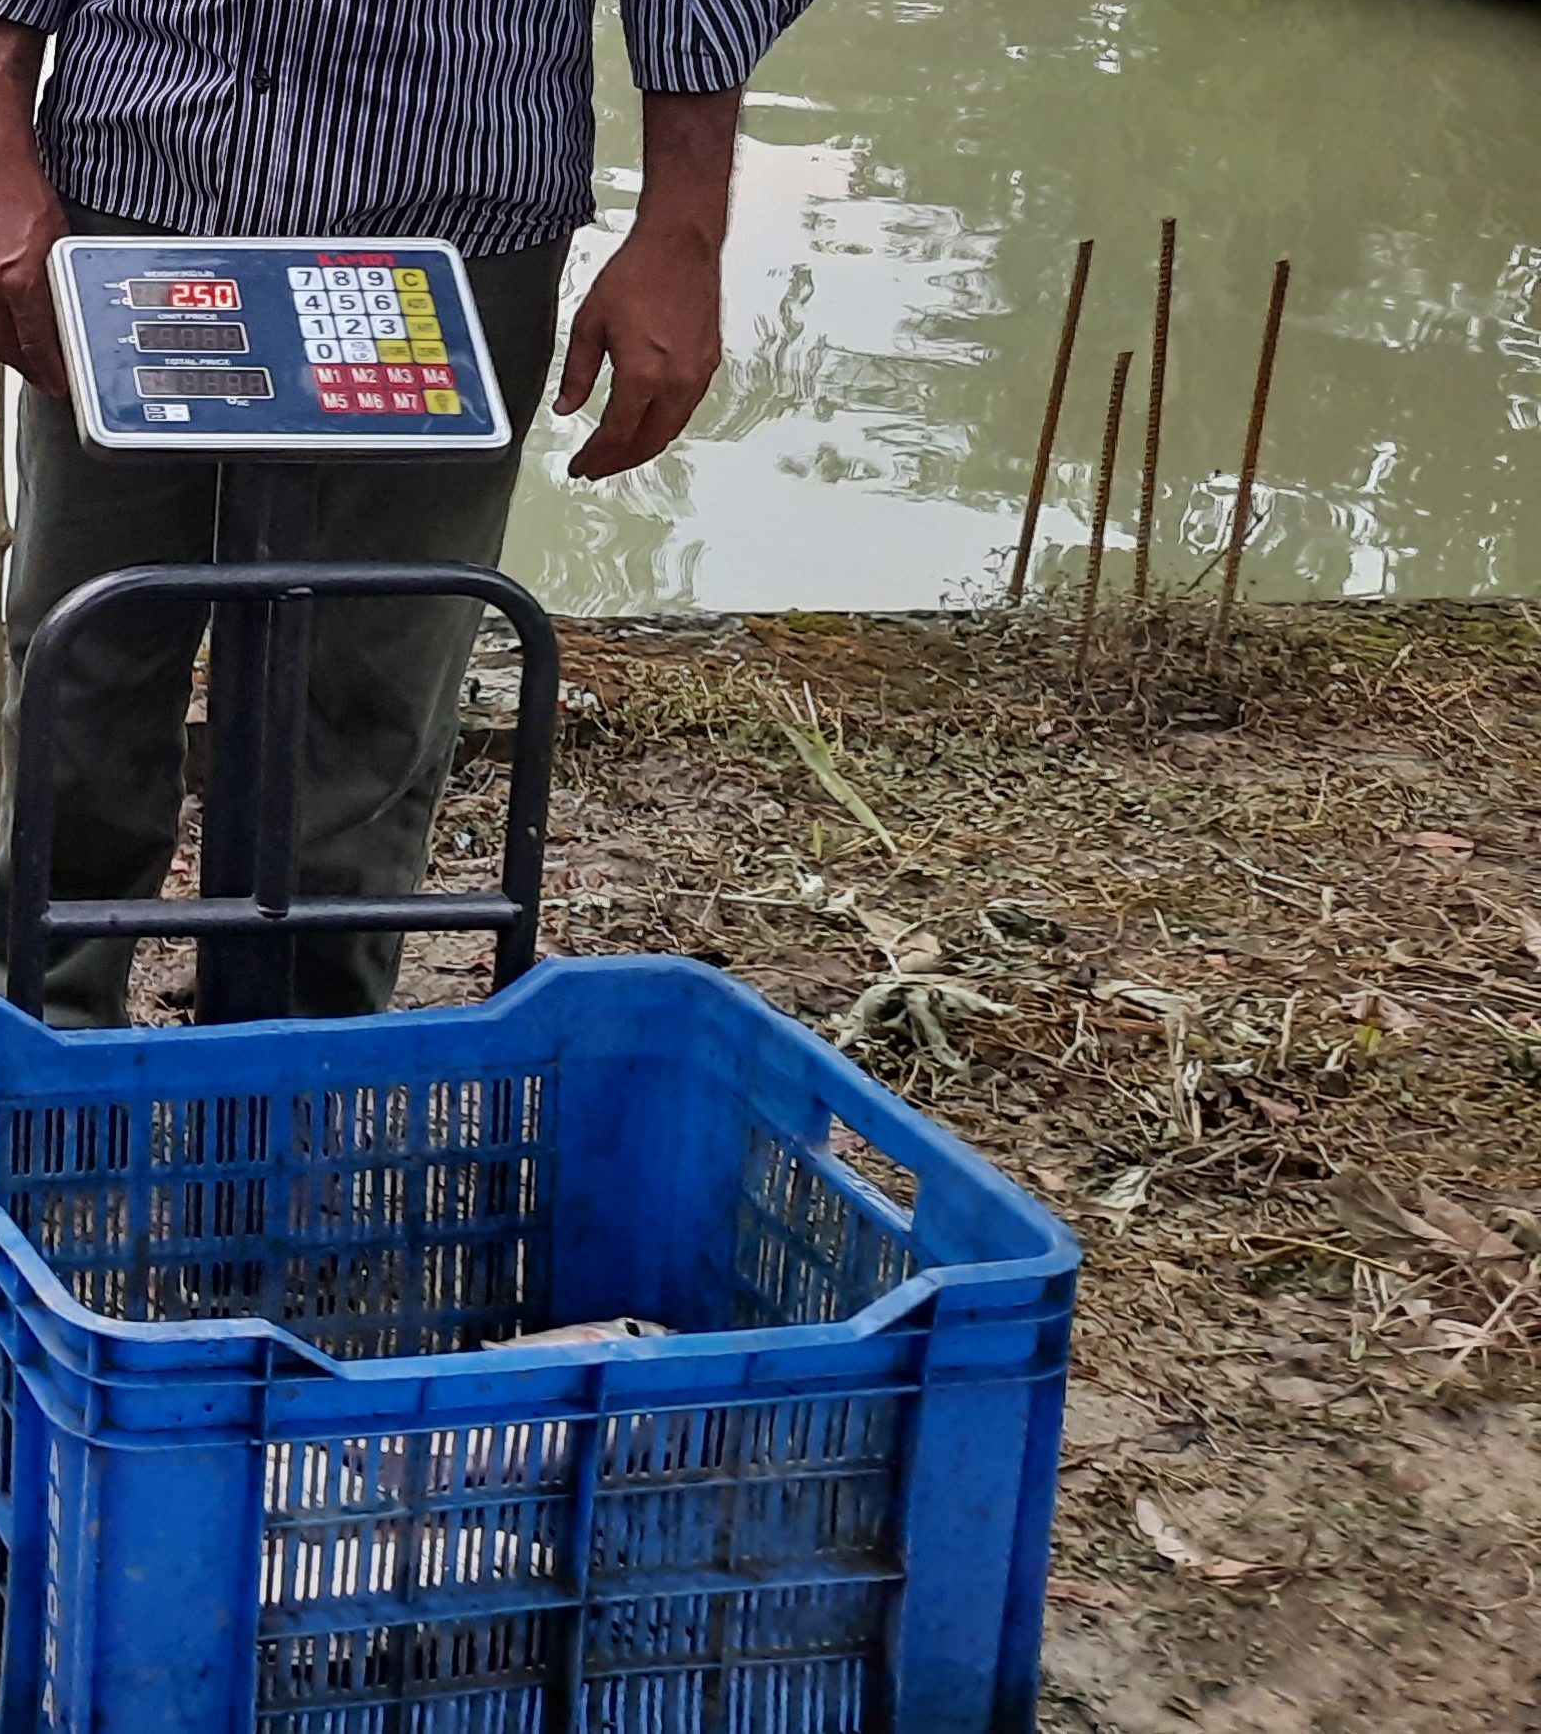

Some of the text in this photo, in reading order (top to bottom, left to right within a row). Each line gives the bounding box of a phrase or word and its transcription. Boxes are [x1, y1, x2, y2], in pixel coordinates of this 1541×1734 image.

[297, 271, 312, 286] 7
[333, 271, 350, 285] 8
[367, 272, 384, 286] 9
[402, 273, 419, 286] C
[305, 295, 322, 310] 4
[339, 295, 355, 310] 5
[375, 295, 391, 310] 6
[311, 320, 324, 334] 1
[345, 320, 363, 334] 2
[379, 320, 396, 334] 3
[316, 344, 332, 359] 0
[317, 368, 341, 383] M1
[351, 368, 377, 383] M2
[386, 368, 414, 383] M3
[422, 369, 449, 384] M4
[321, 393, 349, 408] M5
[356, 393, 385, 408] M6
[392, 394, 417, 409] M7
